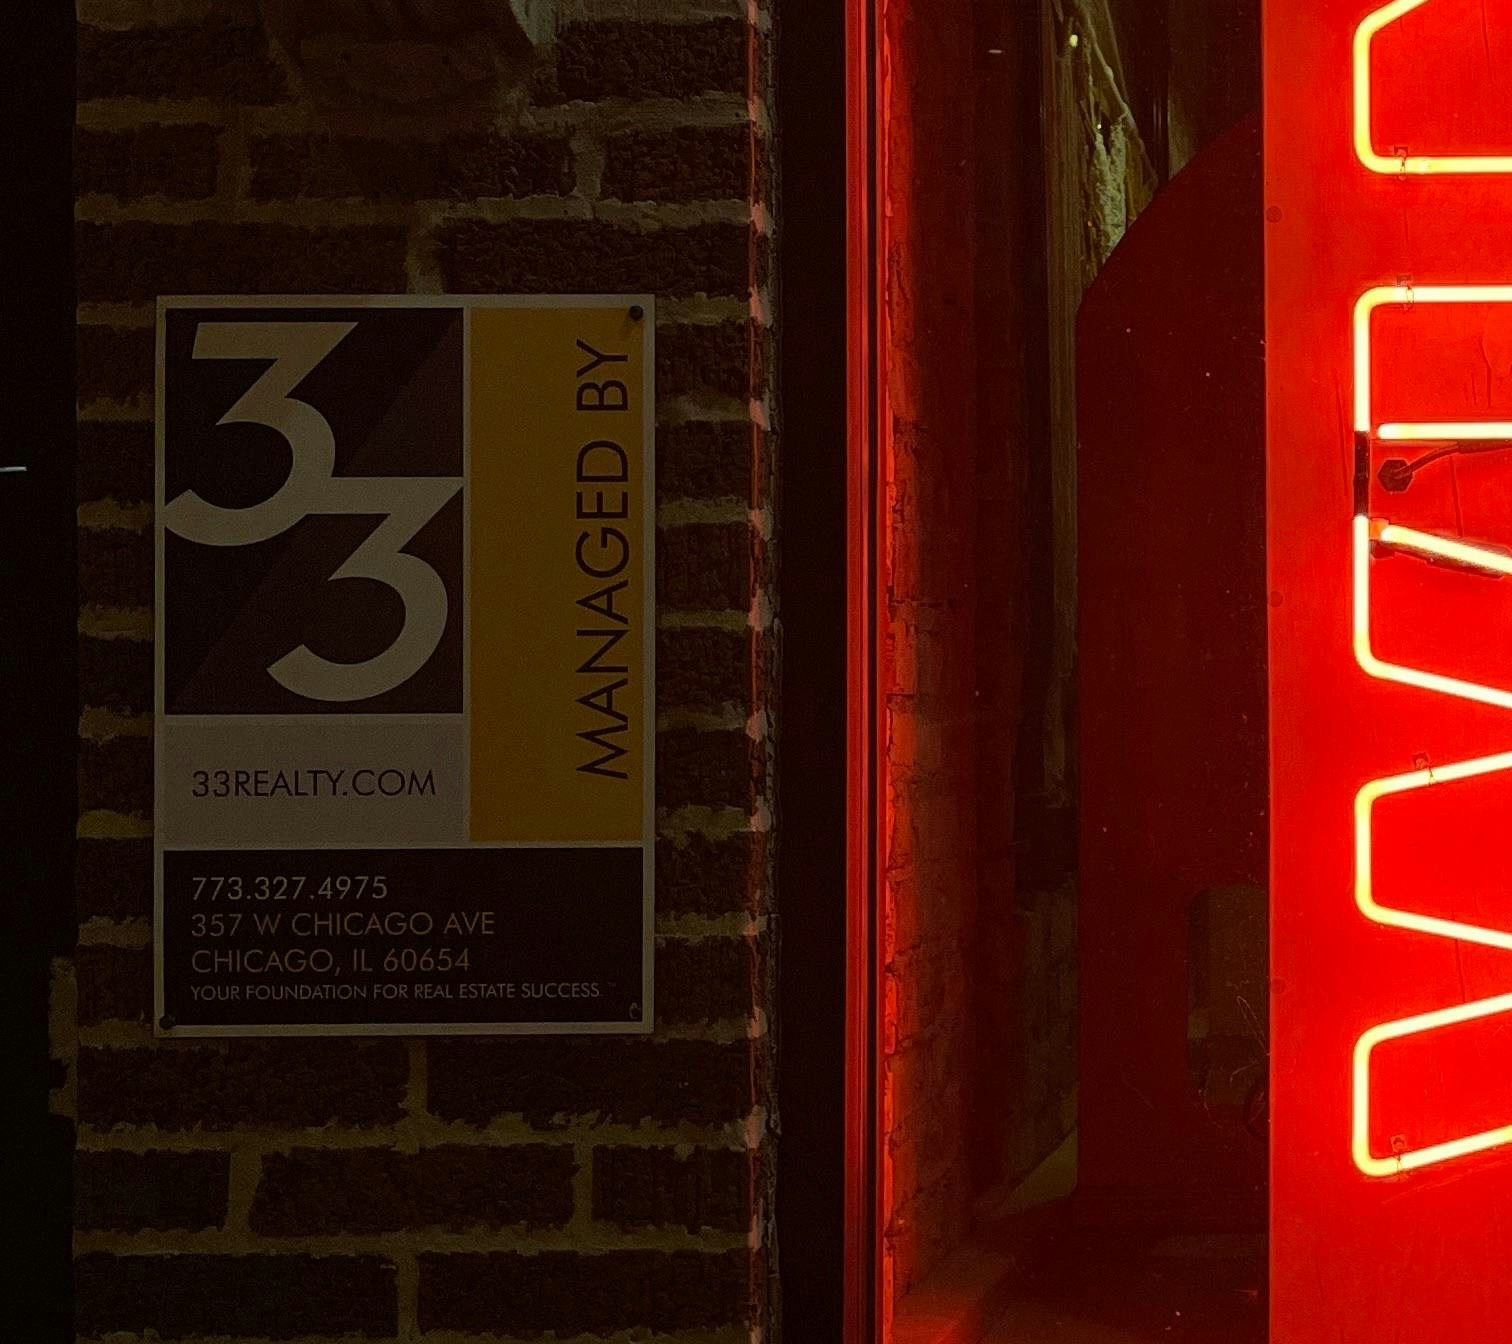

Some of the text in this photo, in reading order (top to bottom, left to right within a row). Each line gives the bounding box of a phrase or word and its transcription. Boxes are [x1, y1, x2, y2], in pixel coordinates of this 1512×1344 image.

[575, 338, 630, 781] MANAGED BY
[191, 769, 436, 797] 33REALTY.COM
[191, 876, 388, 901] 773.327.4975
[191, 911, 496, 937] 357 W CHICAGO AVE
[191, 946, 471, 977] CHICAGO, IL 60654
[190, 985, 240, 1001] YOUR
[246, 984, 367, 1001] FOUNDATION
[373, 983, 408, 1000] FOR
[414, 983, 453, 1000] REAL
[459, 982, 516, 999] ESTATE
